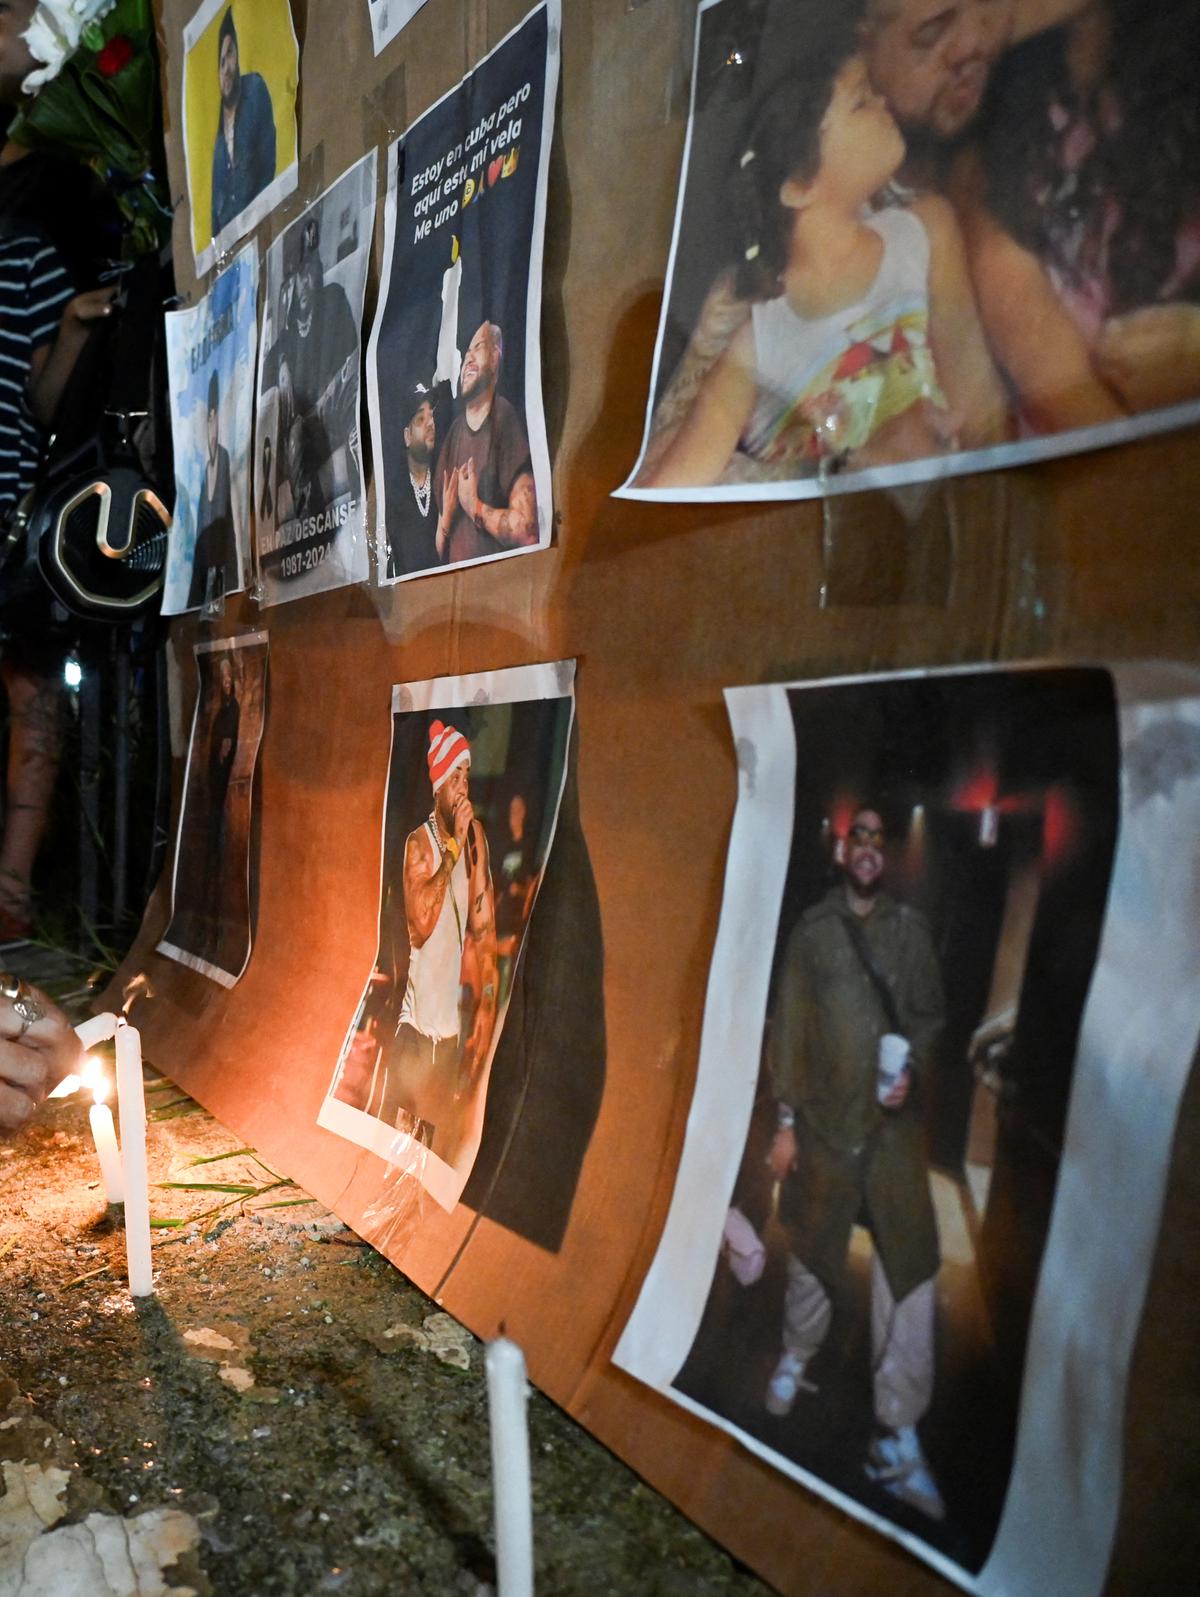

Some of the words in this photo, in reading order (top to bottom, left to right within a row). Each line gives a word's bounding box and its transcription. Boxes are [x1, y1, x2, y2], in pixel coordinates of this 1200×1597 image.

[411, 157, 444, 196] Estoy
[446, 143, 462, 168] en
[464, 112, 496, 152] cuba
[496, 83, 531, 128] pero
[414, 180, 443, 217] aquí
[490, 118, 522, 155] vela
[414, 220, 432, 244] Me
[434, 200, 459, 229] uno
